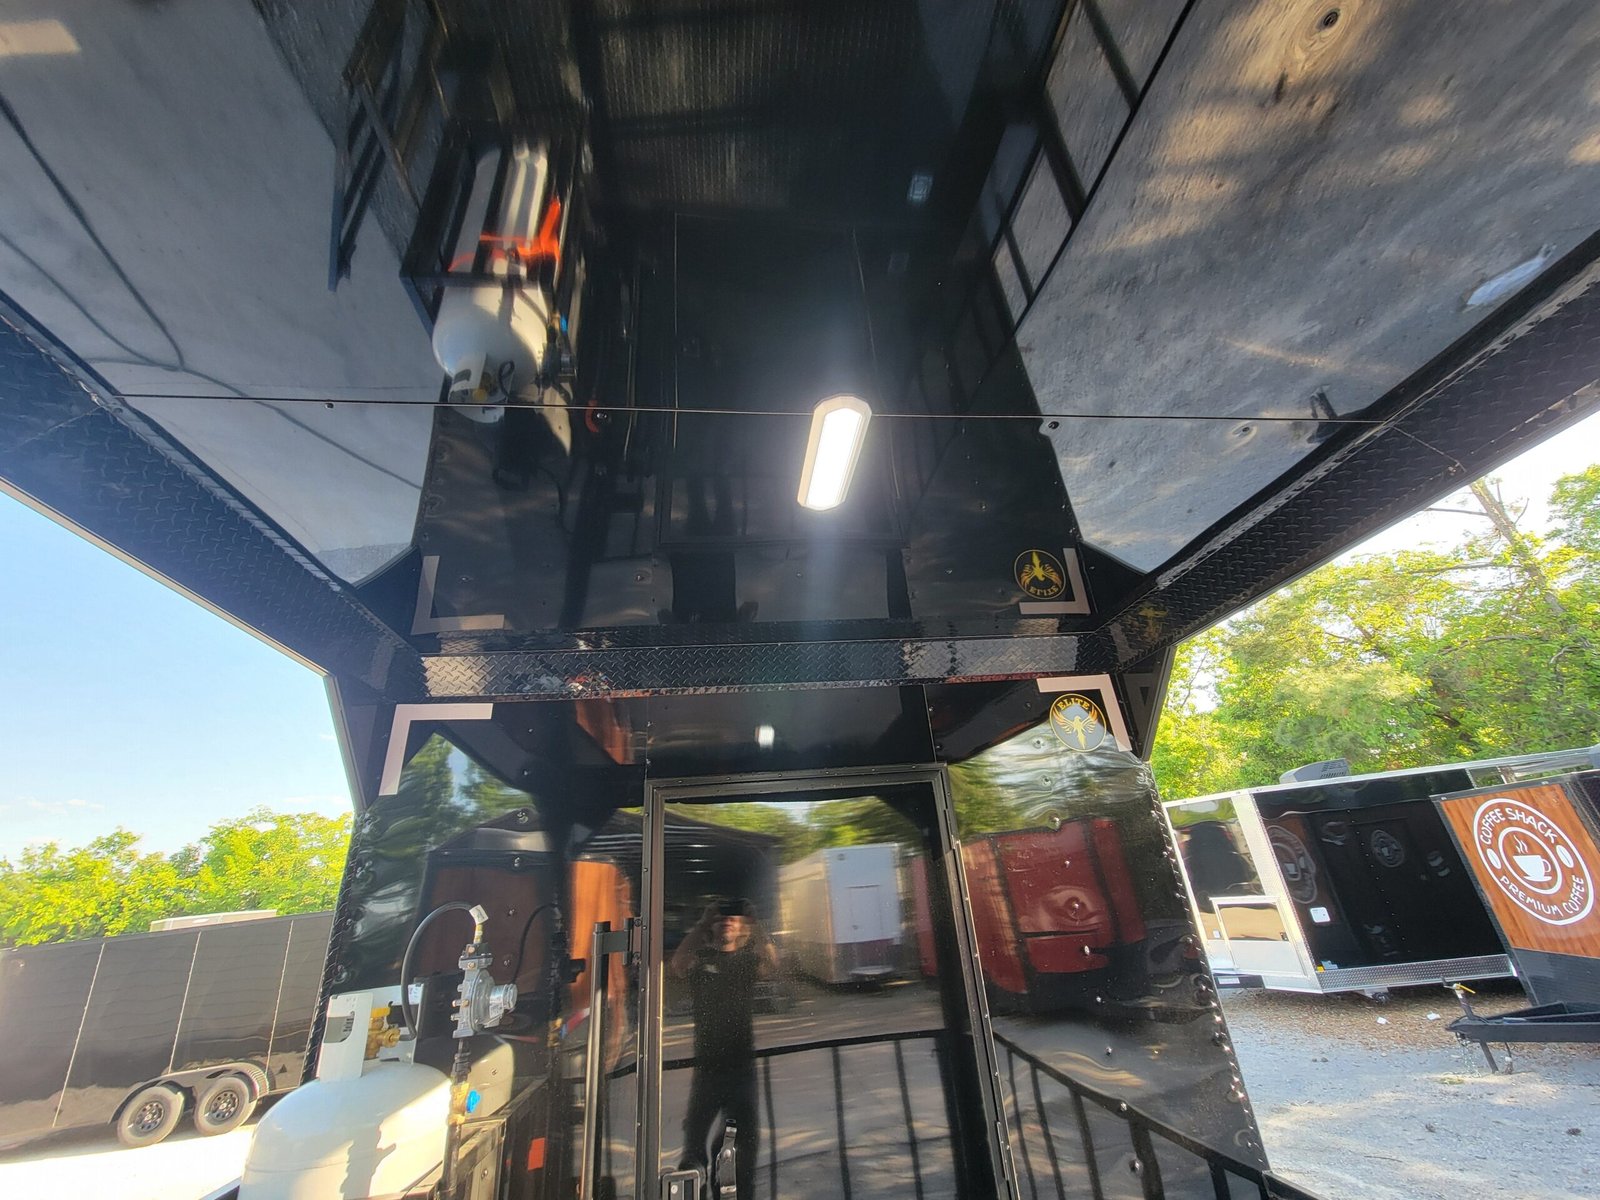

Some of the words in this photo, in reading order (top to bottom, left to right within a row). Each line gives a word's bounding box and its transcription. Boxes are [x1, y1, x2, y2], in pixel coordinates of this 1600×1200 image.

[1057, 697, 1090, 710] ELITE
[1480, 808, 1505, 845] COFFEE
[1505, 807, 1557, 843] SHACK
[1500, 876, 1564, 917] PREMIUM
[1562, 875, 1585, 914] COFFEE
